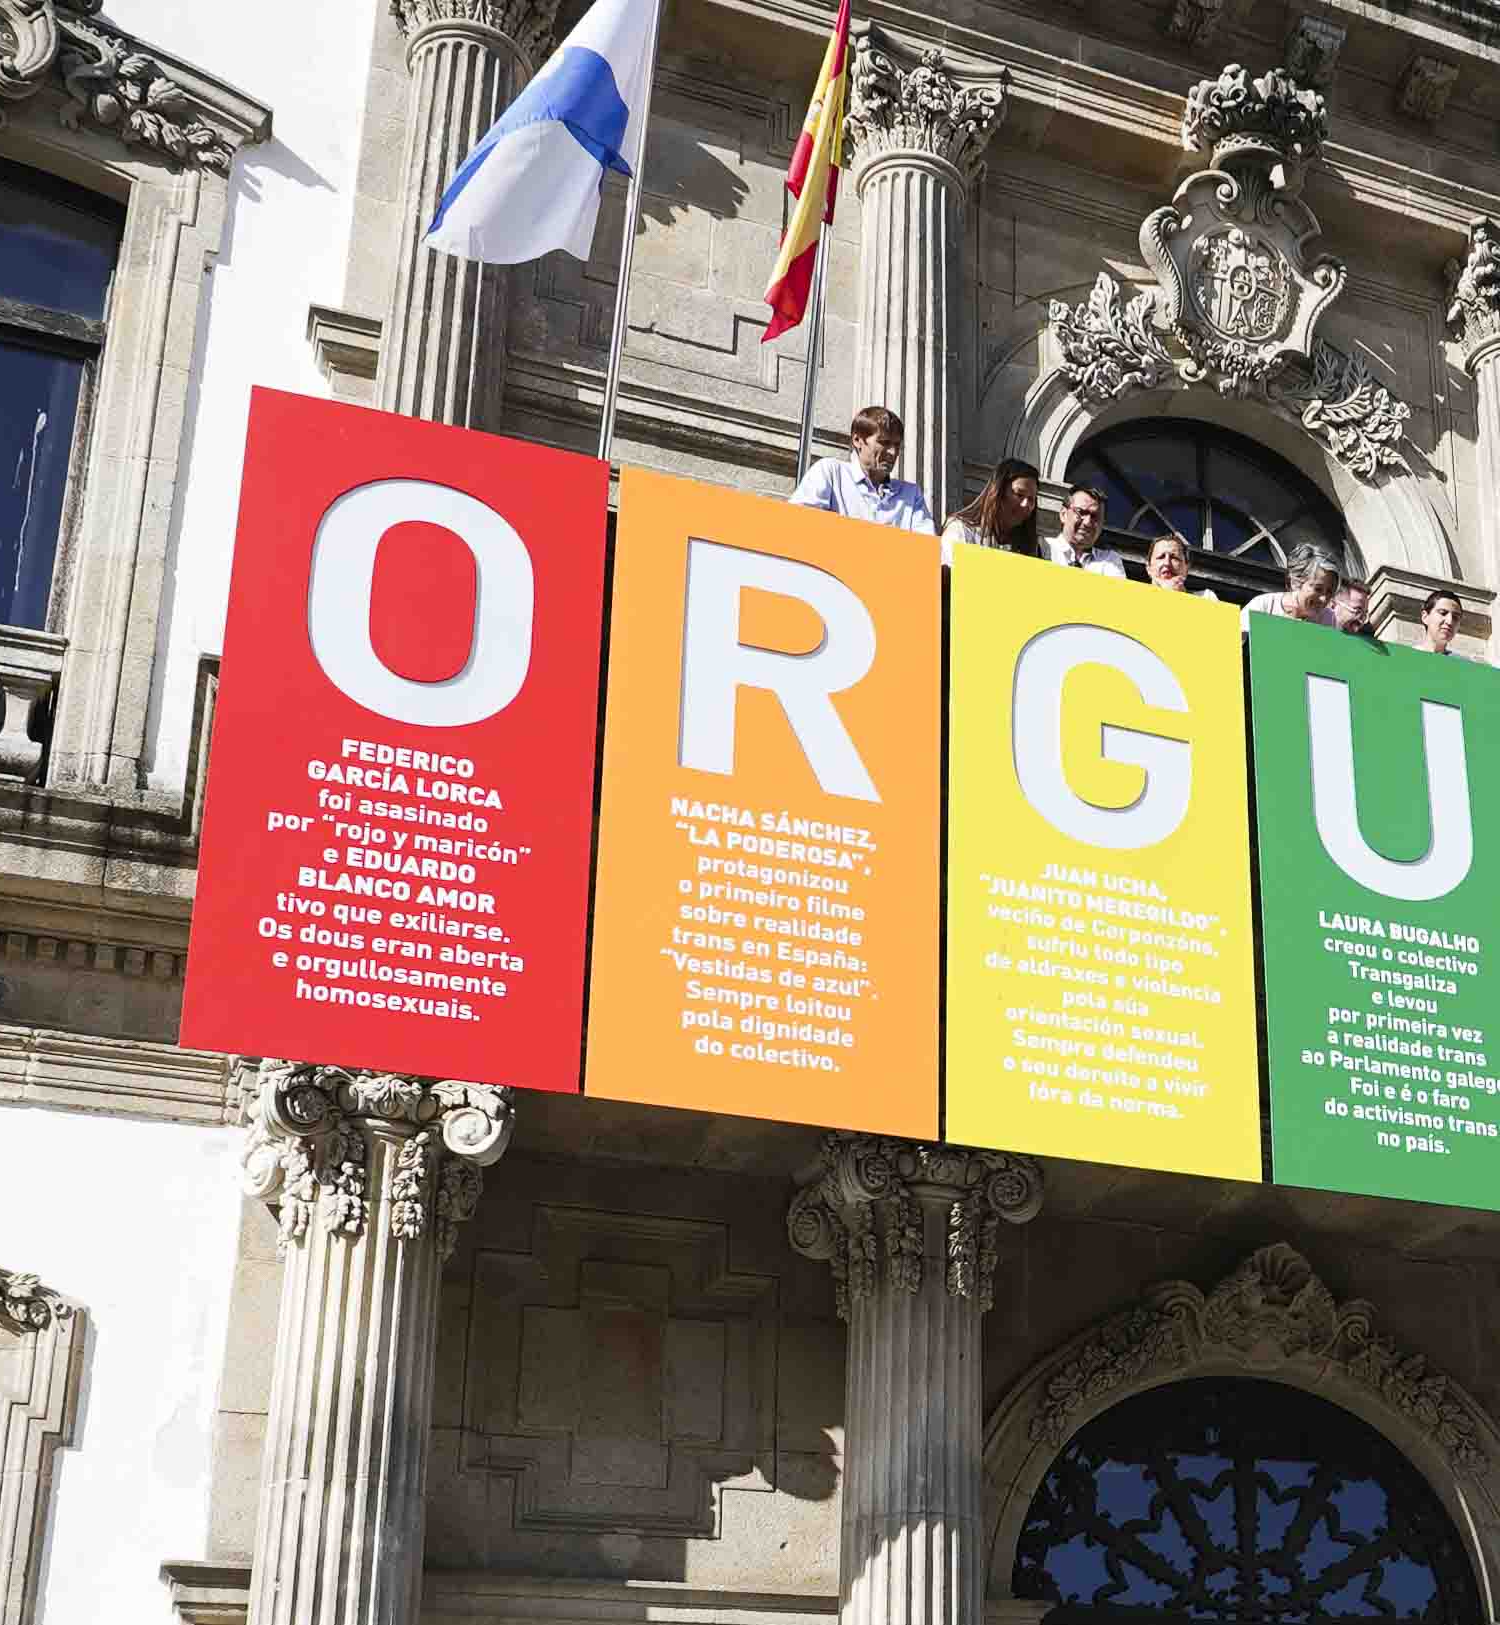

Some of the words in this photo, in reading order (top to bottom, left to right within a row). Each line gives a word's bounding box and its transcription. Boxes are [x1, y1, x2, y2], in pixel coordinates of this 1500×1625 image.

[307, 479, 534, 727] O
[679, 539, 881, 803] R
[1011, 623, 1192, 849] G
[1306, 674, 1473, 901] U
[341, 739, 475, 779] FEDERICO
[307, 760, 410, 795] GARCÍA
[416, 777, 503, 810] LORCA
[319, 788, 352, 812] foi
[358, 799, 488, 833] asasinado
[671, 797, 756, 828] NACHA
[761, 811, 877, 852] SÁNCHEZ,
[267, 812, 315, 832] por
[393, 831, 409, 851] y
[323, 848, 339, 864] e
[346, 846, 476, 884] EDUARDO
[697, 856, 849, 894] protagonizou
[298, 866, 411, 902] BLANCO
[416, 885, 495, 914] AMOR
[679, 879, 693, 894] o
[699, 881, 801, 912] primeiro
[806, 895, 865, 921] filme
[276, 892, 326, 917] tivo
[333, 904, 383, 925] que
[389, 912, 511, 944] exiliarse.
[680, 904, 747, 929] sobre
[753, 916, 862, 946] realidade
[1319, 910, 1386, 938] LAURA
[1389, 922, 1480, 954] BUGALHO
[258, 917, 293, 940] Os
[300, 923, 365, 950] dous
[371, 937, 433, 960] eran
[439, 944, 524, 973] aberta
[672, 926, 736, 953] trans
[742, 940, 771, 958] en
[777, 941, 868, 973] España:
[1323, 938, 1378, 959] creou
[1381, 947, 1394, 961] o
[1397, 950, 1478, 976] colectivo
[272, 952, 289, 968] e
[296, 955, 507, 997] orgullosamente
[778, 968, 807, 989] de
[1348, 960, 1457, 995] Transgaliza
[296, 978, 480, 1021] homosexuais.
[686, 979, 780, 1011] Sempre
[786, 994, 852, 1021] loitou
[1371, 991, 1384, 1005] e
[1387, 989, 1438, 1014] levou
[682, 1009, 733, 1031] pola
[740, 1015, 854, 1048] dignidade
[1328, 1007, 1361, 1025] por
[1366, 1012, 1448, 1039] primeira
[1451, 1026, 1483, 1044] vez
[694, 1035, 725, 1056] do
[729, 1042, 840, 1073] colectivo.
[1301, 1050, 1325, 1066] ao
[1329, 1050, 1442, 1083] Parlamento
[1327, 1030, 1339, 1045] a
[1343, 1032, 1433, 1059] realidade
[1437, 1044, 1487, 1067] trans
[1350, 1077, 1380, 1097] Foi
[1384, 1086, 1396, 1100] e
[1400, 1083, 1412, 1102] é
[1417, 1090, 1428, 1105] o
[1432, 1088, 1471, 1110] faro
[1324, 1097, 1349, 1117] do
[1353, 1104, 1444, 1130] activismo
[1448, 1115, 1498, 1137] trans
[1377, 1131, 1401, 1148] no
[1405, 1133, 1451, 1155] país.
